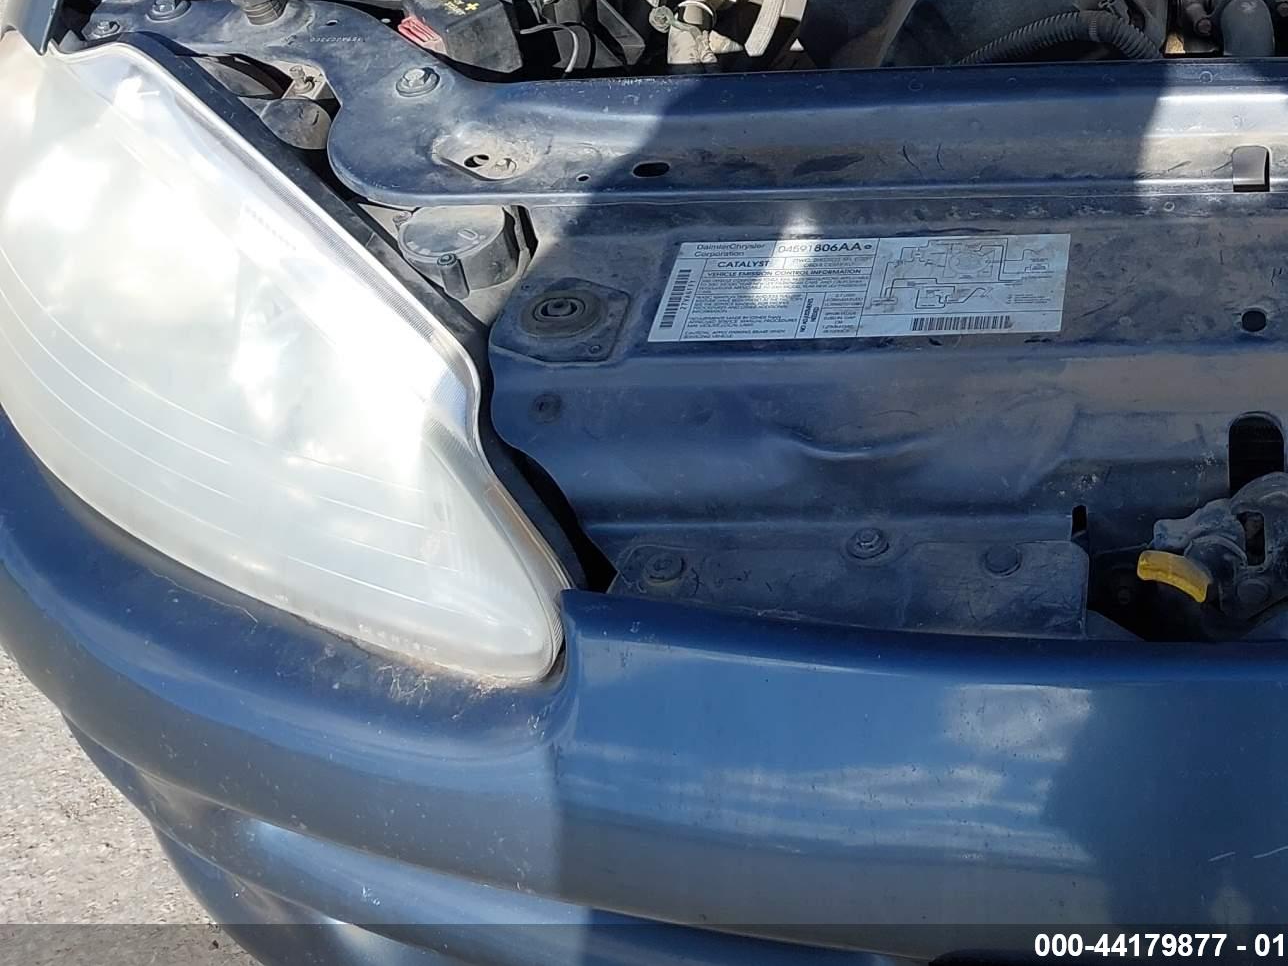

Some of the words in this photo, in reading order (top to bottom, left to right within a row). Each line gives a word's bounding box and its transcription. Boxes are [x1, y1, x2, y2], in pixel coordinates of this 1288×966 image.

[696, 242, 766, 251] DaimlerChrysler
[694, 251, 745, 259] Corporation
[717, 261, 770, 269] CATALYST
